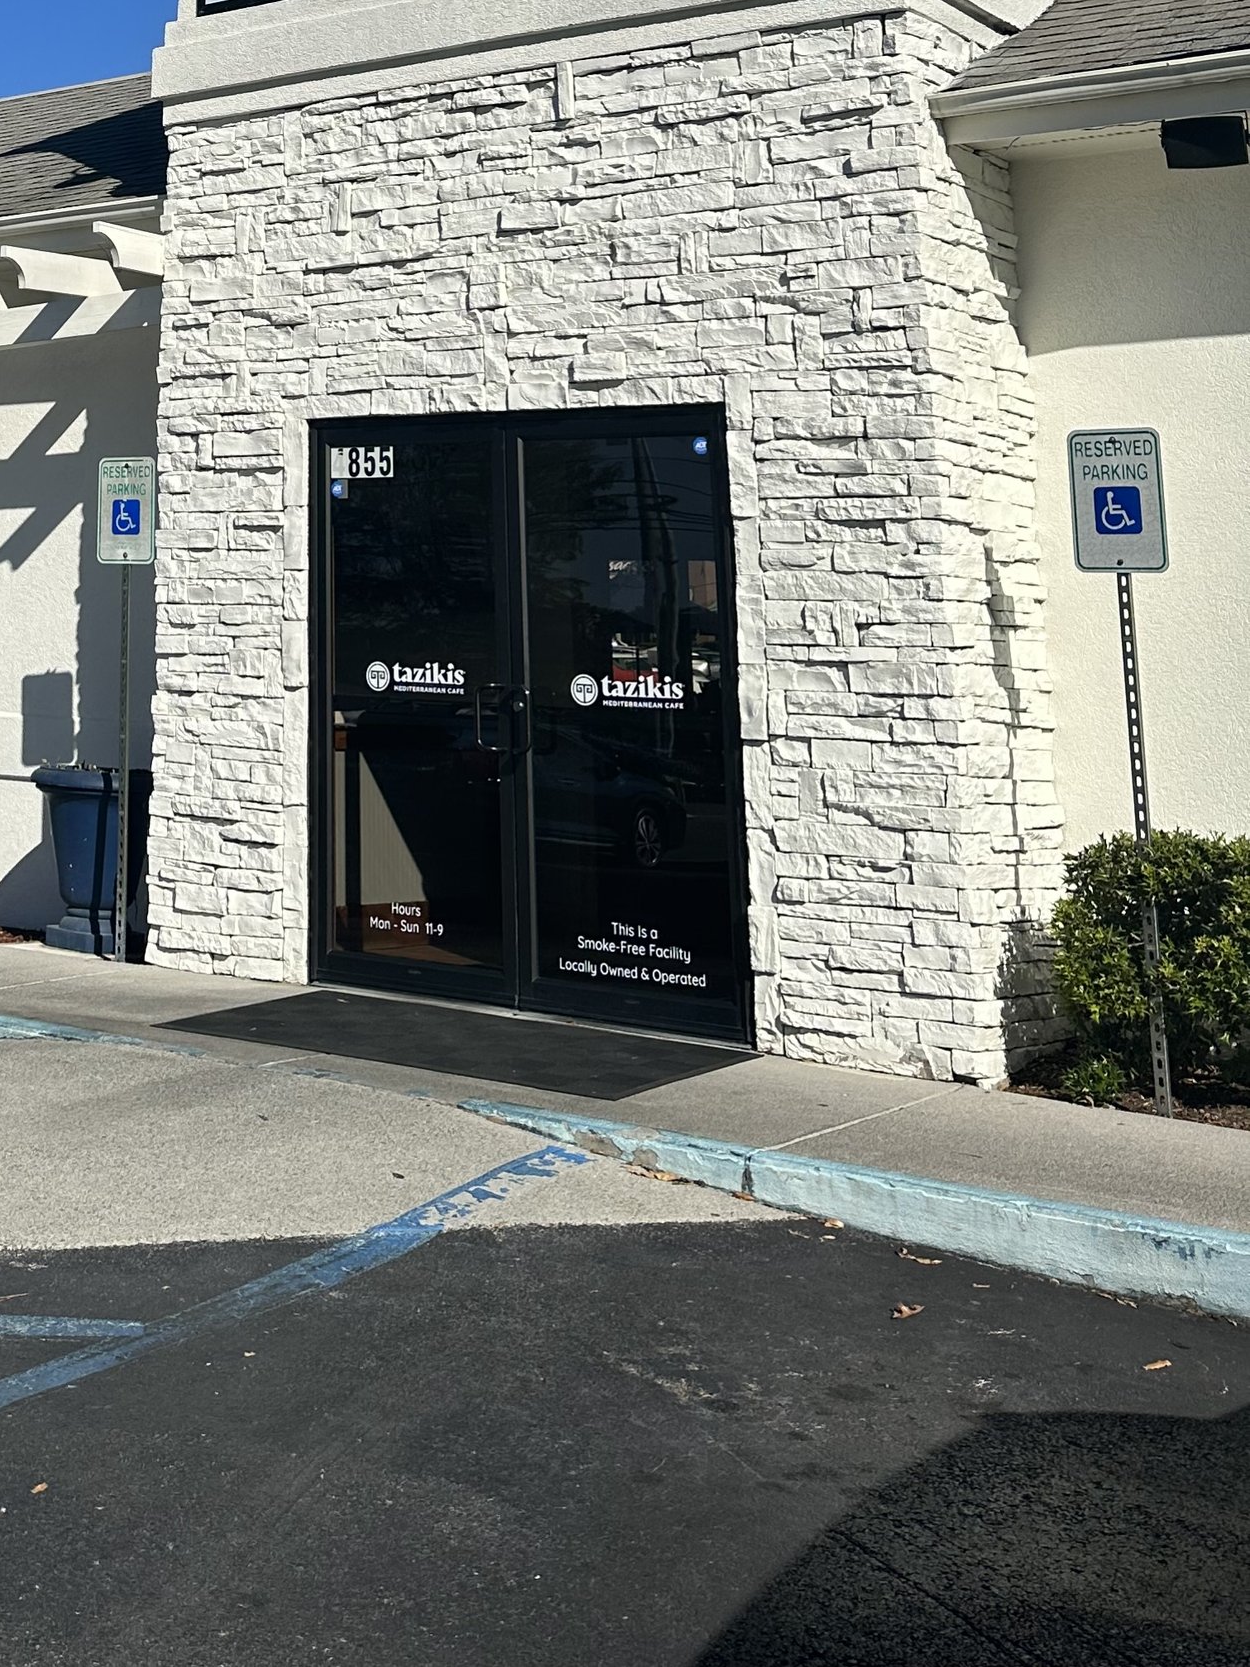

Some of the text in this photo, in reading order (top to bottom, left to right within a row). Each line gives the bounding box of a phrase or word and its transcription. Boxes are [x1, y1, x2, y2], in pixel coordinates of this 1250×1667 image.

[1074, 439, 1153, 458] RESERVED
[103, 465, 150, 478] RESERVED
[1082, 463, 1148, 480] PARKING
[107, 483, 146, 495] PARKING
[392, 662, 464, 685] tazikis
[393, 685, 464, 695] MEDITERRANEAN CAFE
[601, 675, 684, 700] tazikis
[602, 699, 684, 710] MEDITERRANEAN CAFE
[391, 902, 421, 917] Hours
[370, 916, 391, 930] Mon
[400, 920, 420, 933] Sun
[425, 922, 444, 936] 11-9
[611, 921, 658, 940] This Is a
[577, 935, 691, 964] Smoke-Free Facility
[559, 957, 707, 987] Locally Owned & Operated
